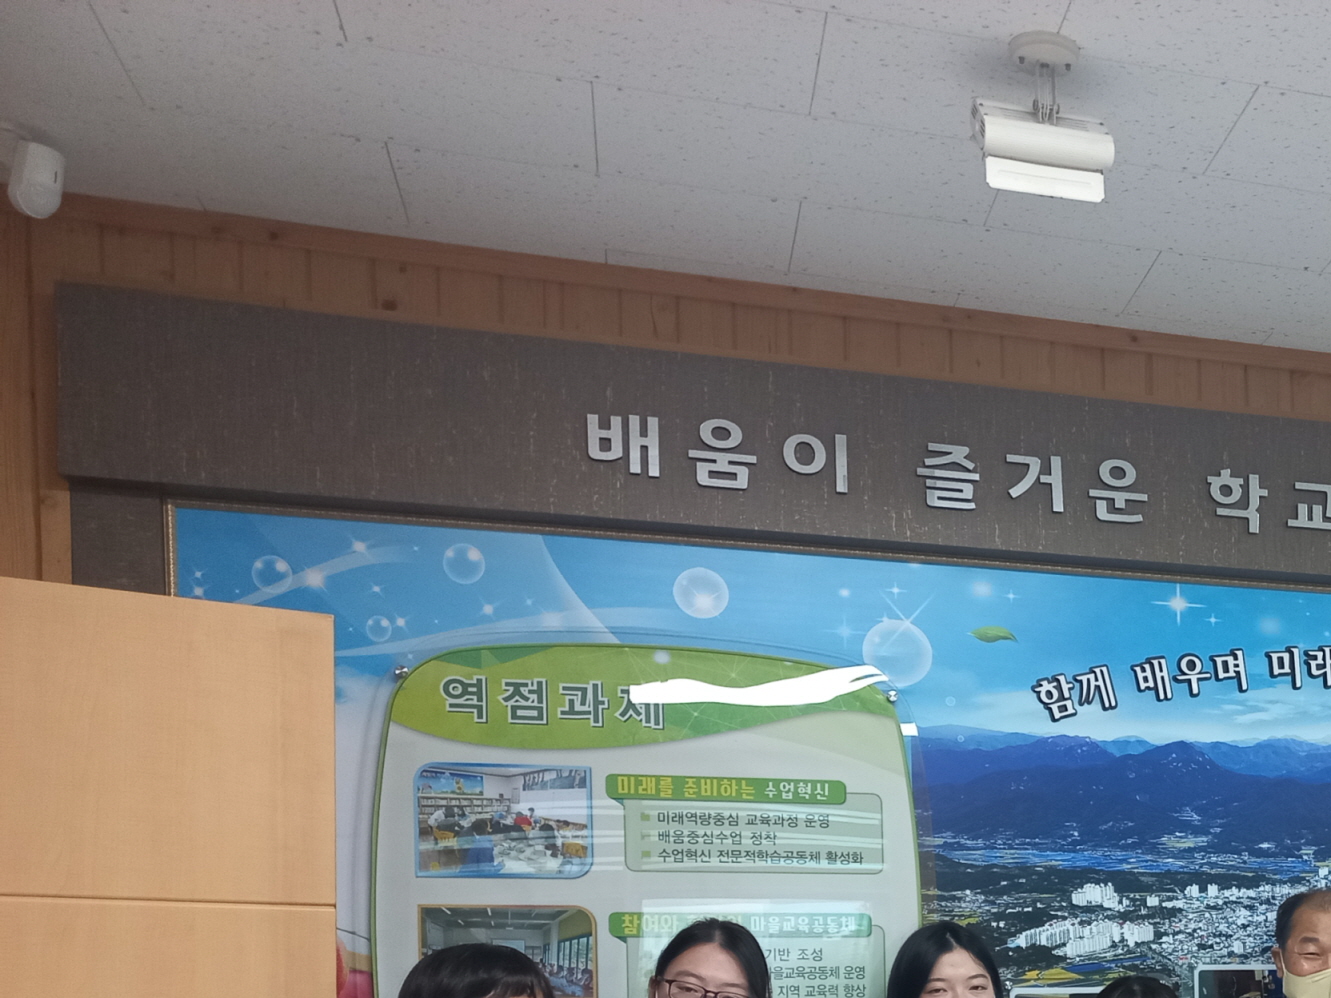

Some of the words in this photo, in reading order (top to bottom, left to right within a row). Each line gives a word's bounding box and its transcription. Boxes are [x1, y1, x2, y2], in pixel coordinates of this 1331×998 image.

[586, 413, 848, 494] 배움이
[916, 441, 1148, 523] 즐거운
[1031, 664, 1118, 722] 함께
[1130, 647, 1249, 701] 배우며
[617, 776, 674, 798] 미래를
[683, 778, 755, 800] 준비하는
[764, 781, 829, 800] 수업혁신
[657, 811, 739, 827] 미래역량중심
[745, 813, 799, 829] 교육과정
[803, 814, 830, 829] 운영
[657, 830, 743, 846] 배움중심수업
[750, 831, 777, 846] 정착
[657, 848, 712, 864] 수업혁신
[717, 849, 821, 865] 전문적학습공동체
[825, 850, 864, 866] 활성화
[797, 947, 823, 962] 조성
[770, 965, 839, 980] 을교육공동체
[843, 965, 866, 980] 운영
[777, 984, 800, 998] 지역
[804, 984, 839, 998] 교육력
[843, 984, 867, 998] 향상
